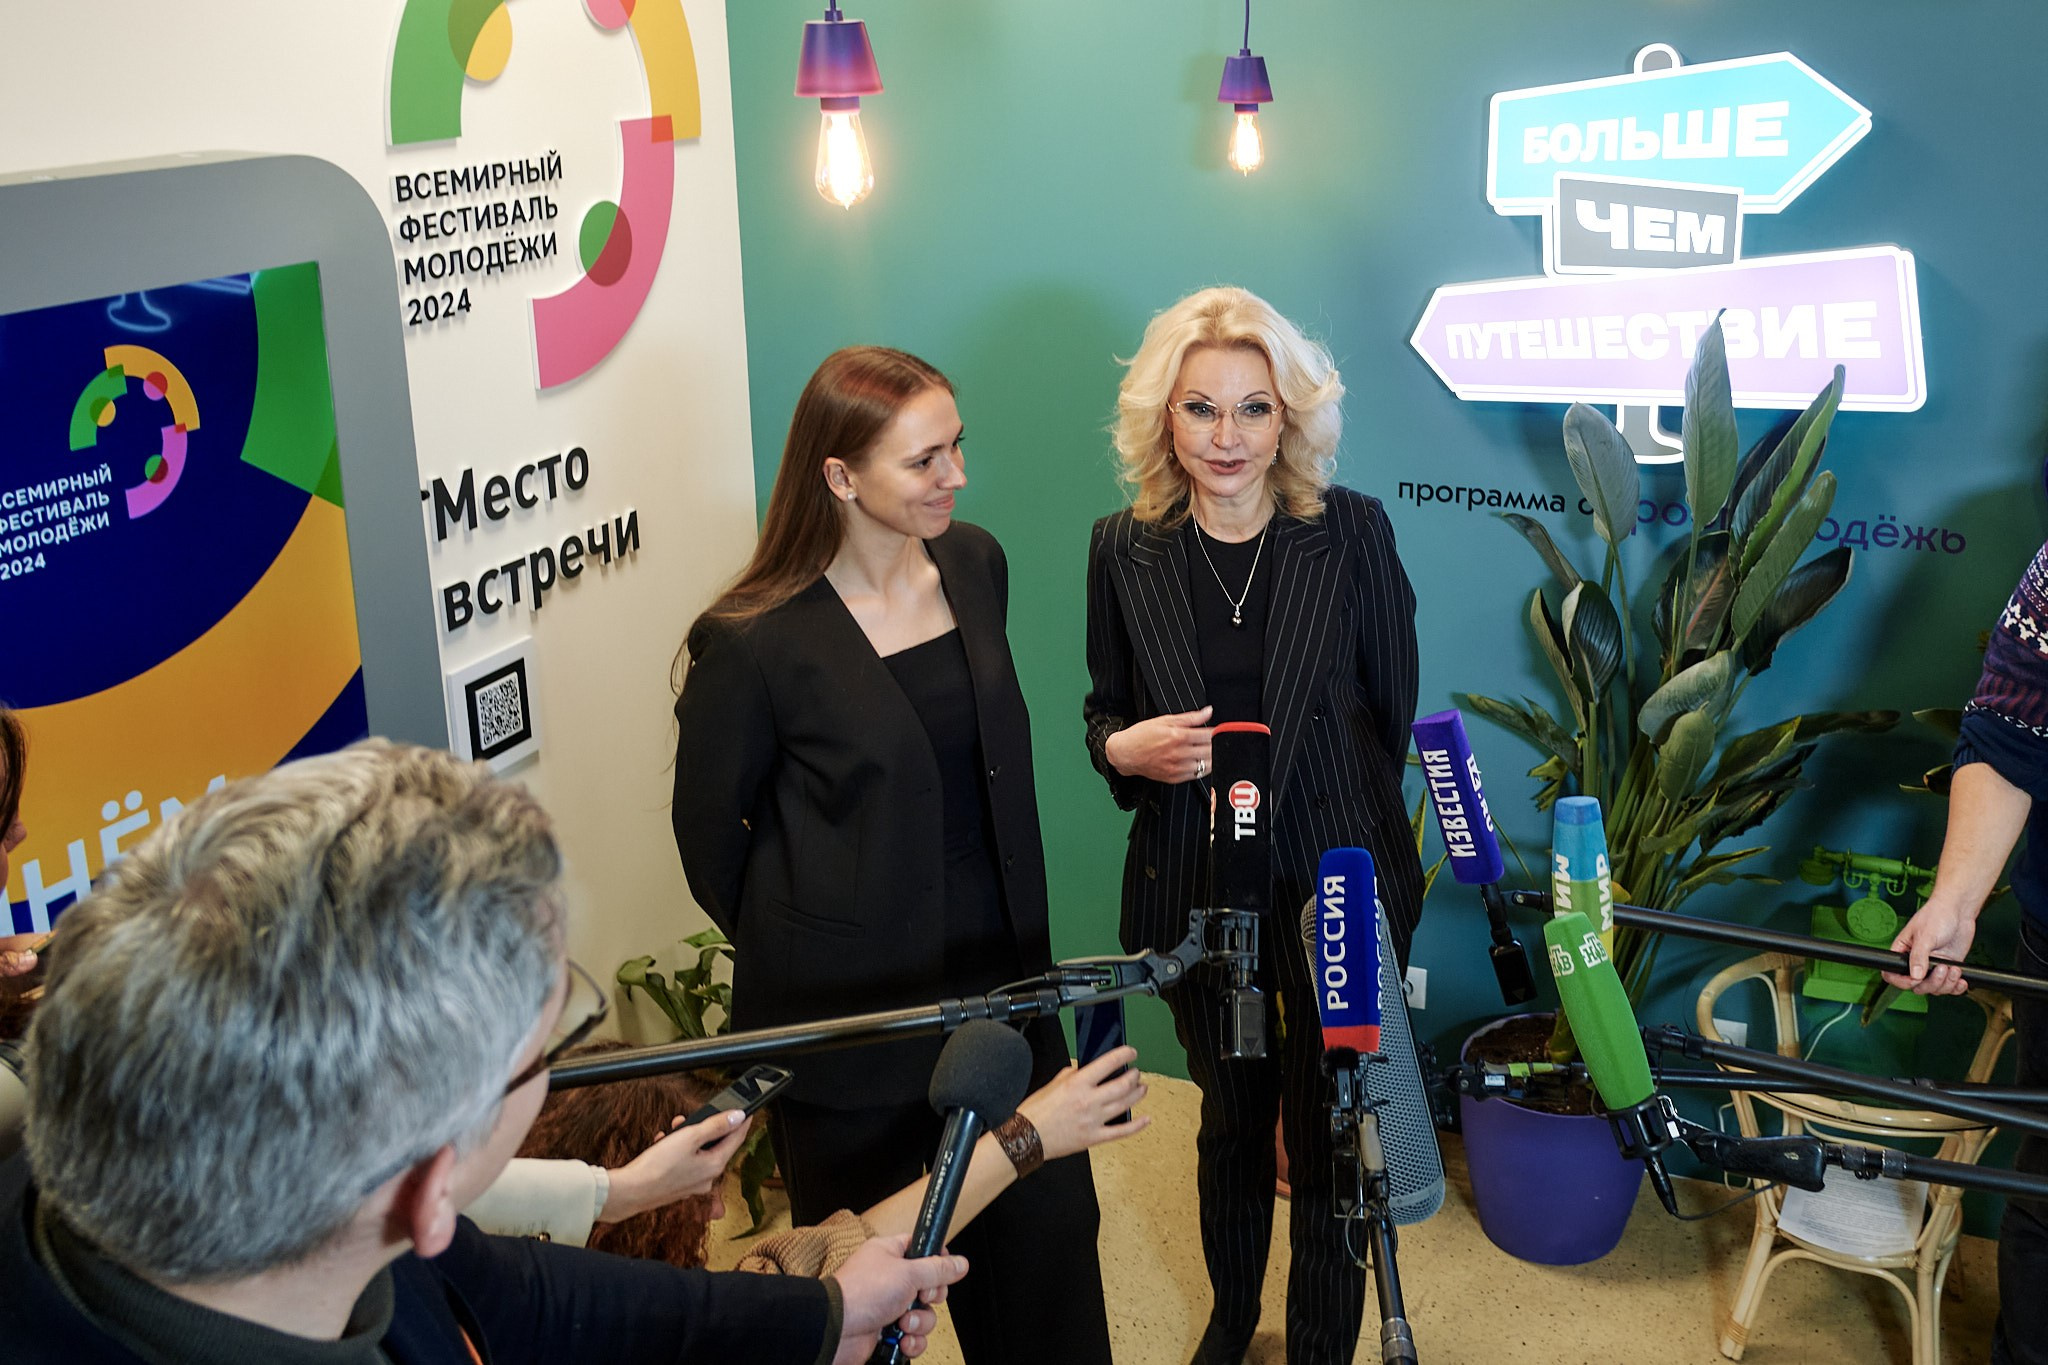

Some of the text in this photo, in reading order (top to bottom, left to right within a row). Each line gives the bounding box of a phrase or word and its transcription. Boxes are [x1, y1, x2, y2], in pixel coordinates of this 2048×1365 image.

[1522, 100, 1790, 165] БОЛЬШЕ
[395, 150, 563, 203] ВСЕМИРНЫЙ
[399, 195, 559, 244] ФЕСТИВАЛЬ
[1574, 198, 1726, 255] ЧЕМ
[403, 231, 558, 285] МОЛОДЁЖИ
[407, 288, 472, 326] 2024
[1444, 300, 1882, 362] ПУТЕШЕСТВИЕ
[0, 462, 112, 512] СЕМИРНЫЙ
[1398, 481, 1566, 513] программа
[0, 511, 110, 559] МОЛОДЁЖИ
[0, 552, 46, 581] 2024
[442, 510, 640, 633] встречи
[1233, 785, 1257, 841] ТВЦ
[1421, 749, 1477, 858] ИЗВЕСТИЯ
[1555, 853, 1573, 920] МИ
[1322, 875, 1349, 1010] РОССИЯ
